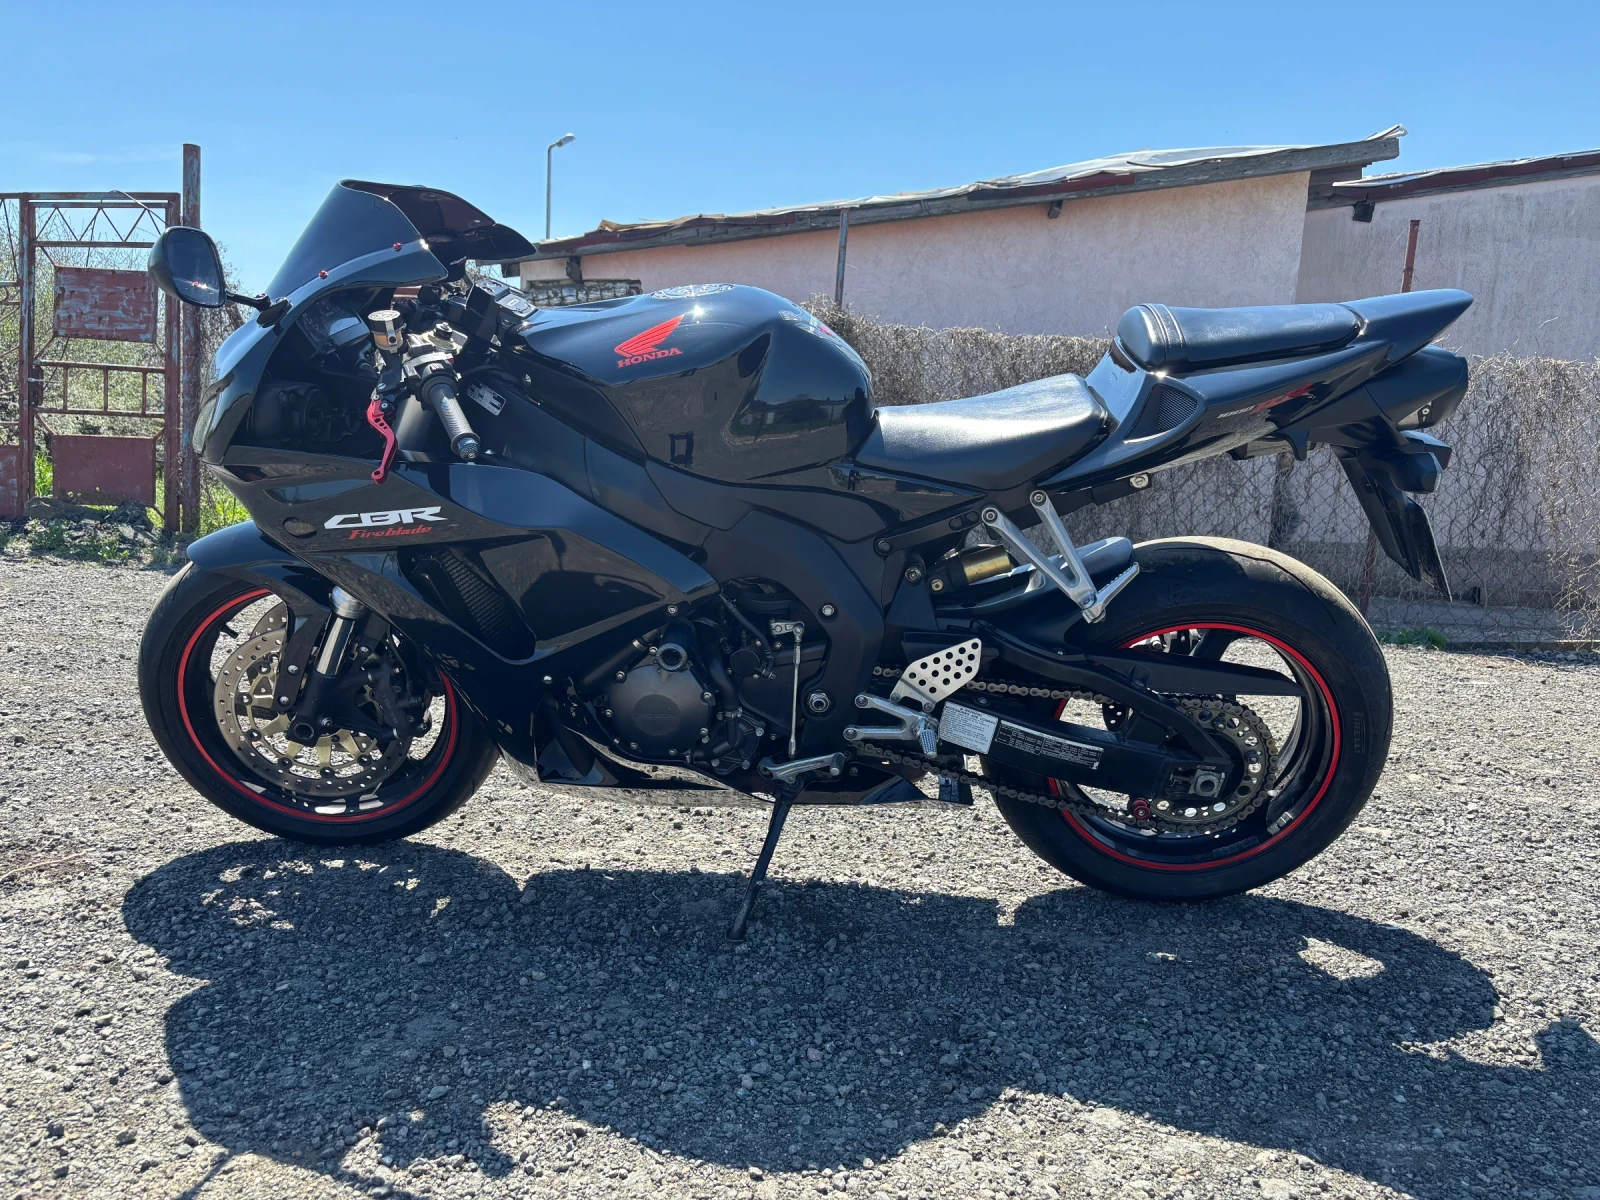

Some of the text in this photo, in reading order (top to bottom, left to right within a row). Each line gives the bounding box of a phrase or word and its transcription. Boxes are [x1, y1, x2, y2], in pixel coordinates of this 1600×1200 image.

[617, 347, 683, 369] HONDA
[323, 506, 448, 529] CBR
[348, 524, 433, 540] Fireblade
